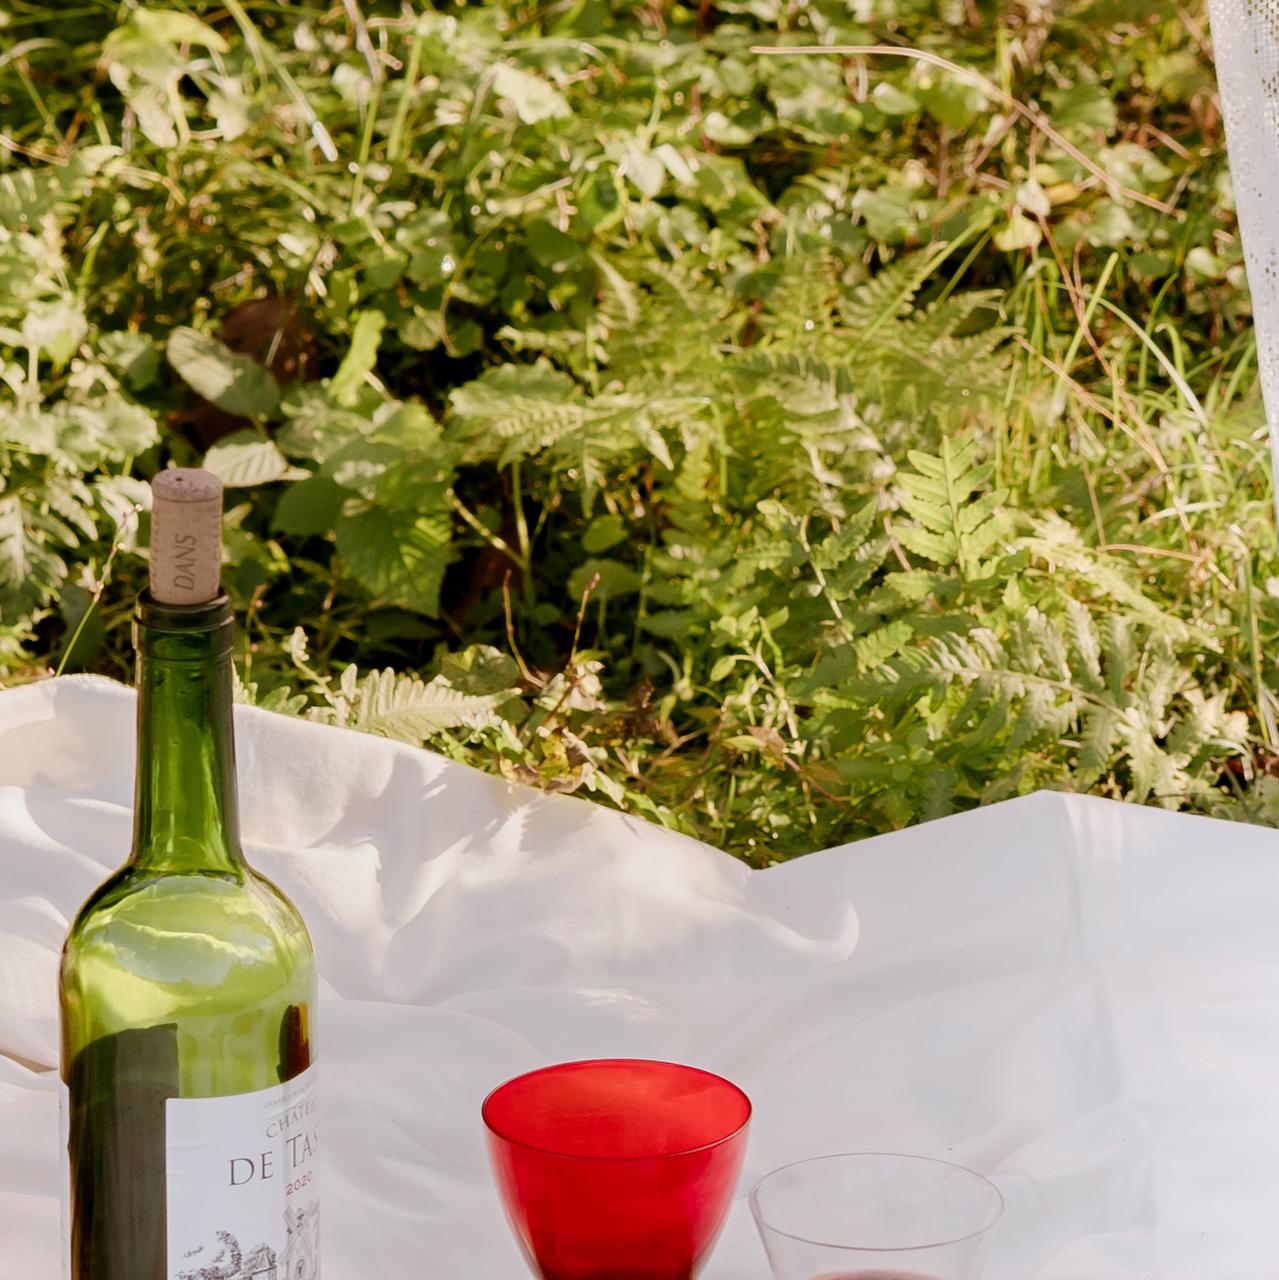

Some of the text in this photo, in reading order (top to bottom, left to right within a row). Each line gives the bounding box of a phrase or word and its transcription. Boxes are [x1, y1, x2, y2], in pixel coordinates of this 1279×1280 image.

[173, 533, 196, 591] DANS
[228, 1150, 273, 1186] DE
[285, 1170, 312, 1196] 2020
